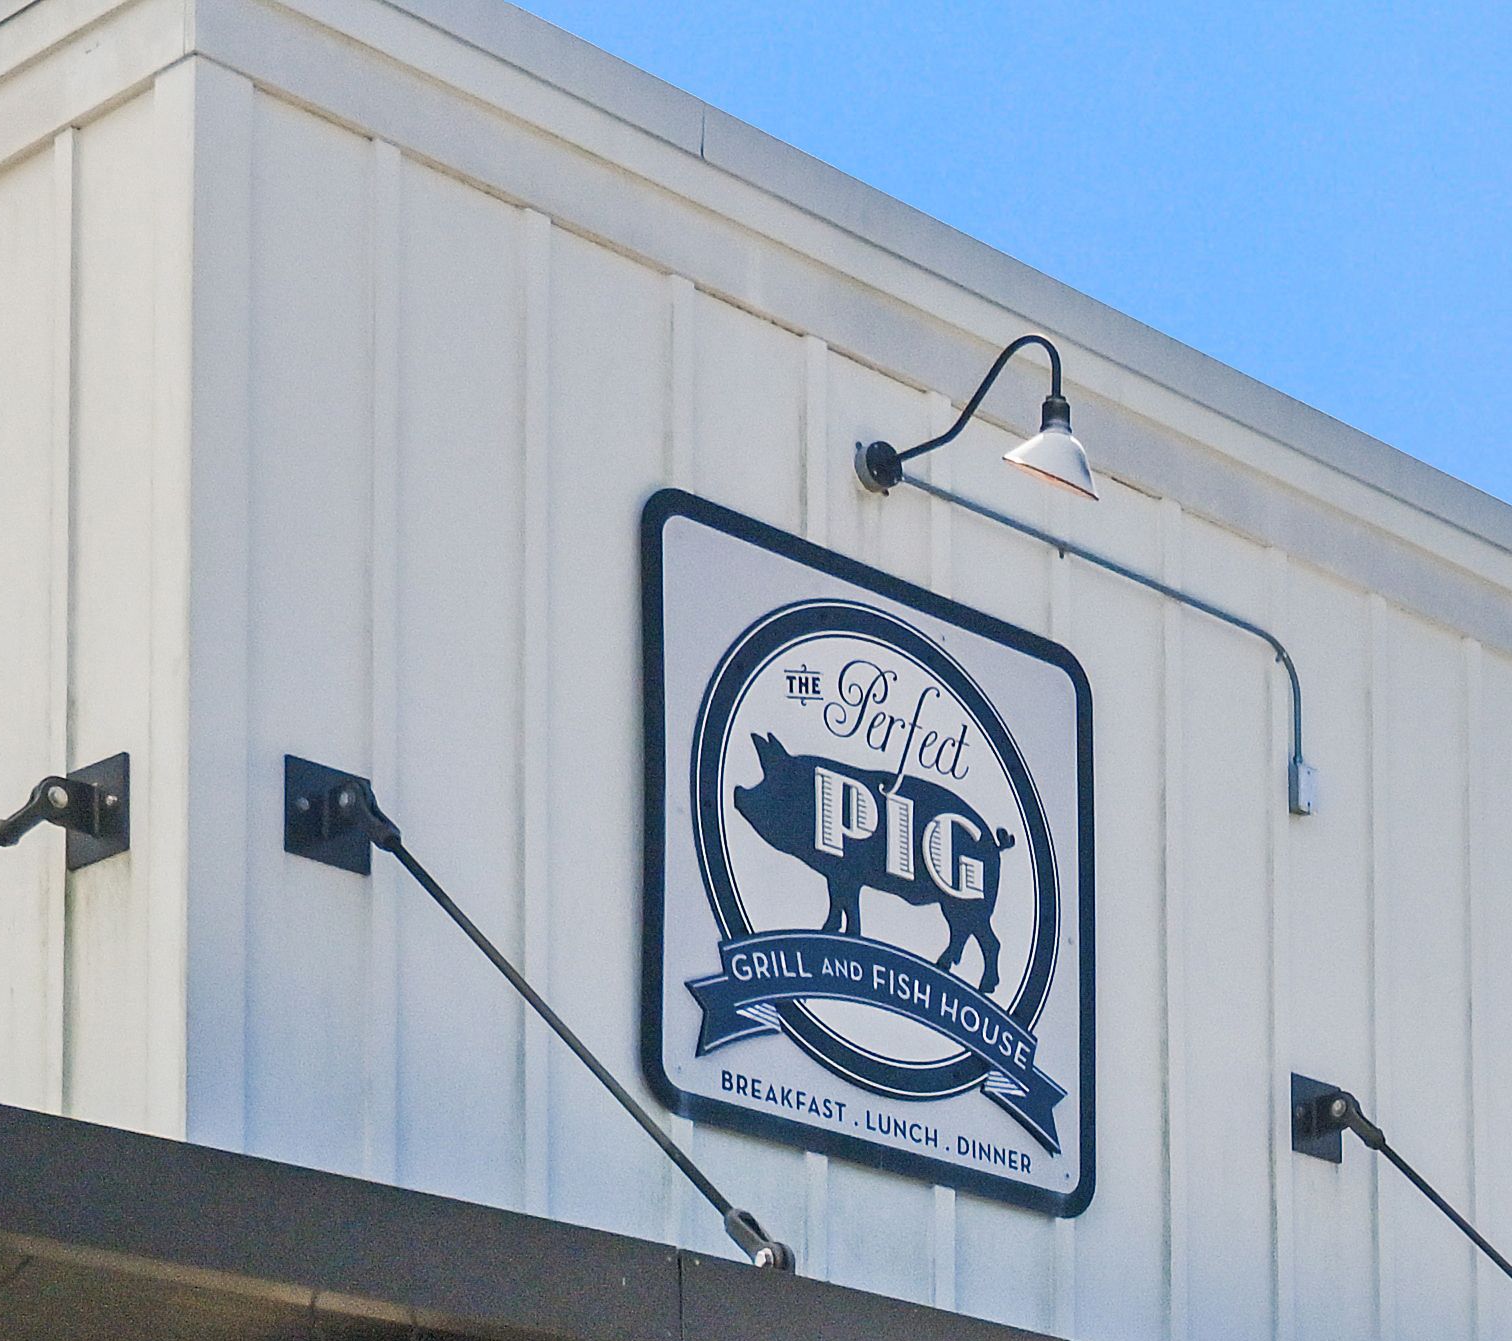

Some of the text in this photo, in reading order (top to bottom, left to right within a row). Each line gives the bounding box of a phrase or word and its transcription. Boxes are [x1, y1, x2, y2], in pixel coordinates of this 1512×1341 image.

[785, 660, 970, 795] THE Perfect
[813, 766, 986, 900] PIG
[731, 952, 1033, 1070] GRILL AND FISH HOUSE
[720, 1069, 1034, 1175] BREAKFAST LUNCH DINNER
